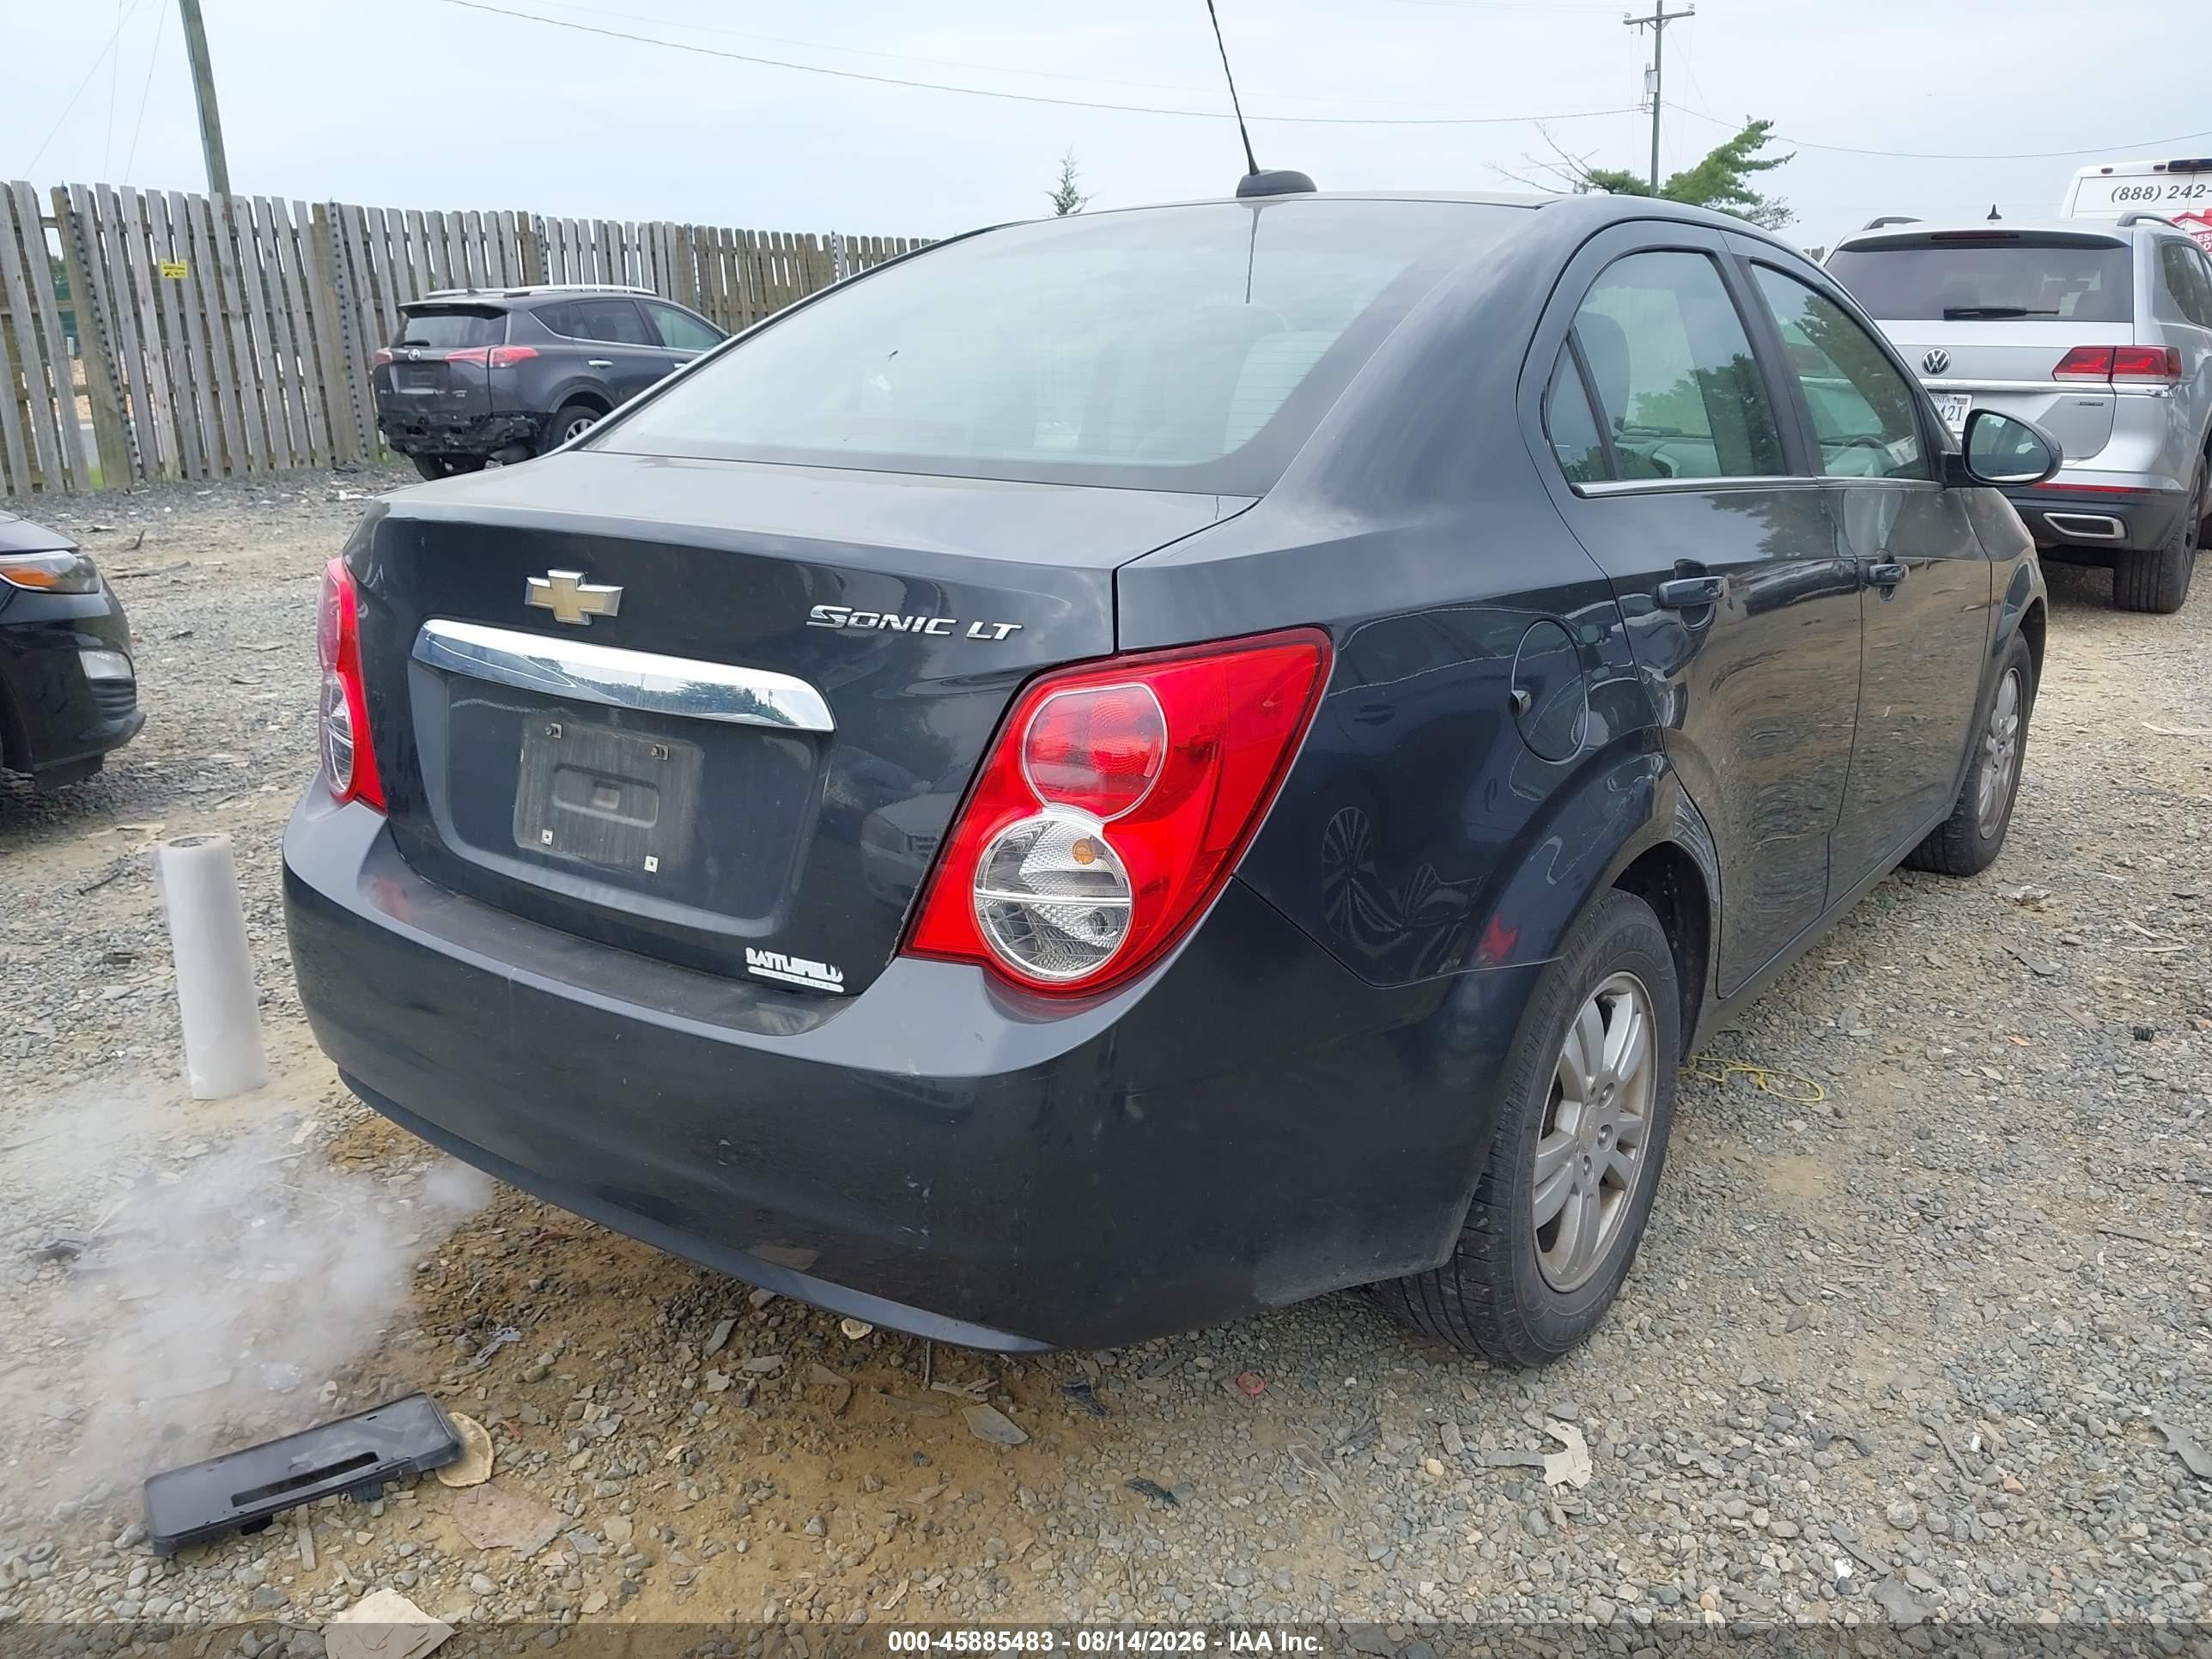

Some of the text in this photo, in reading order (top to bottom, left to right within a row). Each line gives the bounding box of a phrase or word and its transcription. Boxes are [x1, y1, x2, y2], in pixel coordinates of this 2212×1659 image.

[2111, 185, 2162, 204] (888)
[805, 605, 1024, 641] SONIC LT
